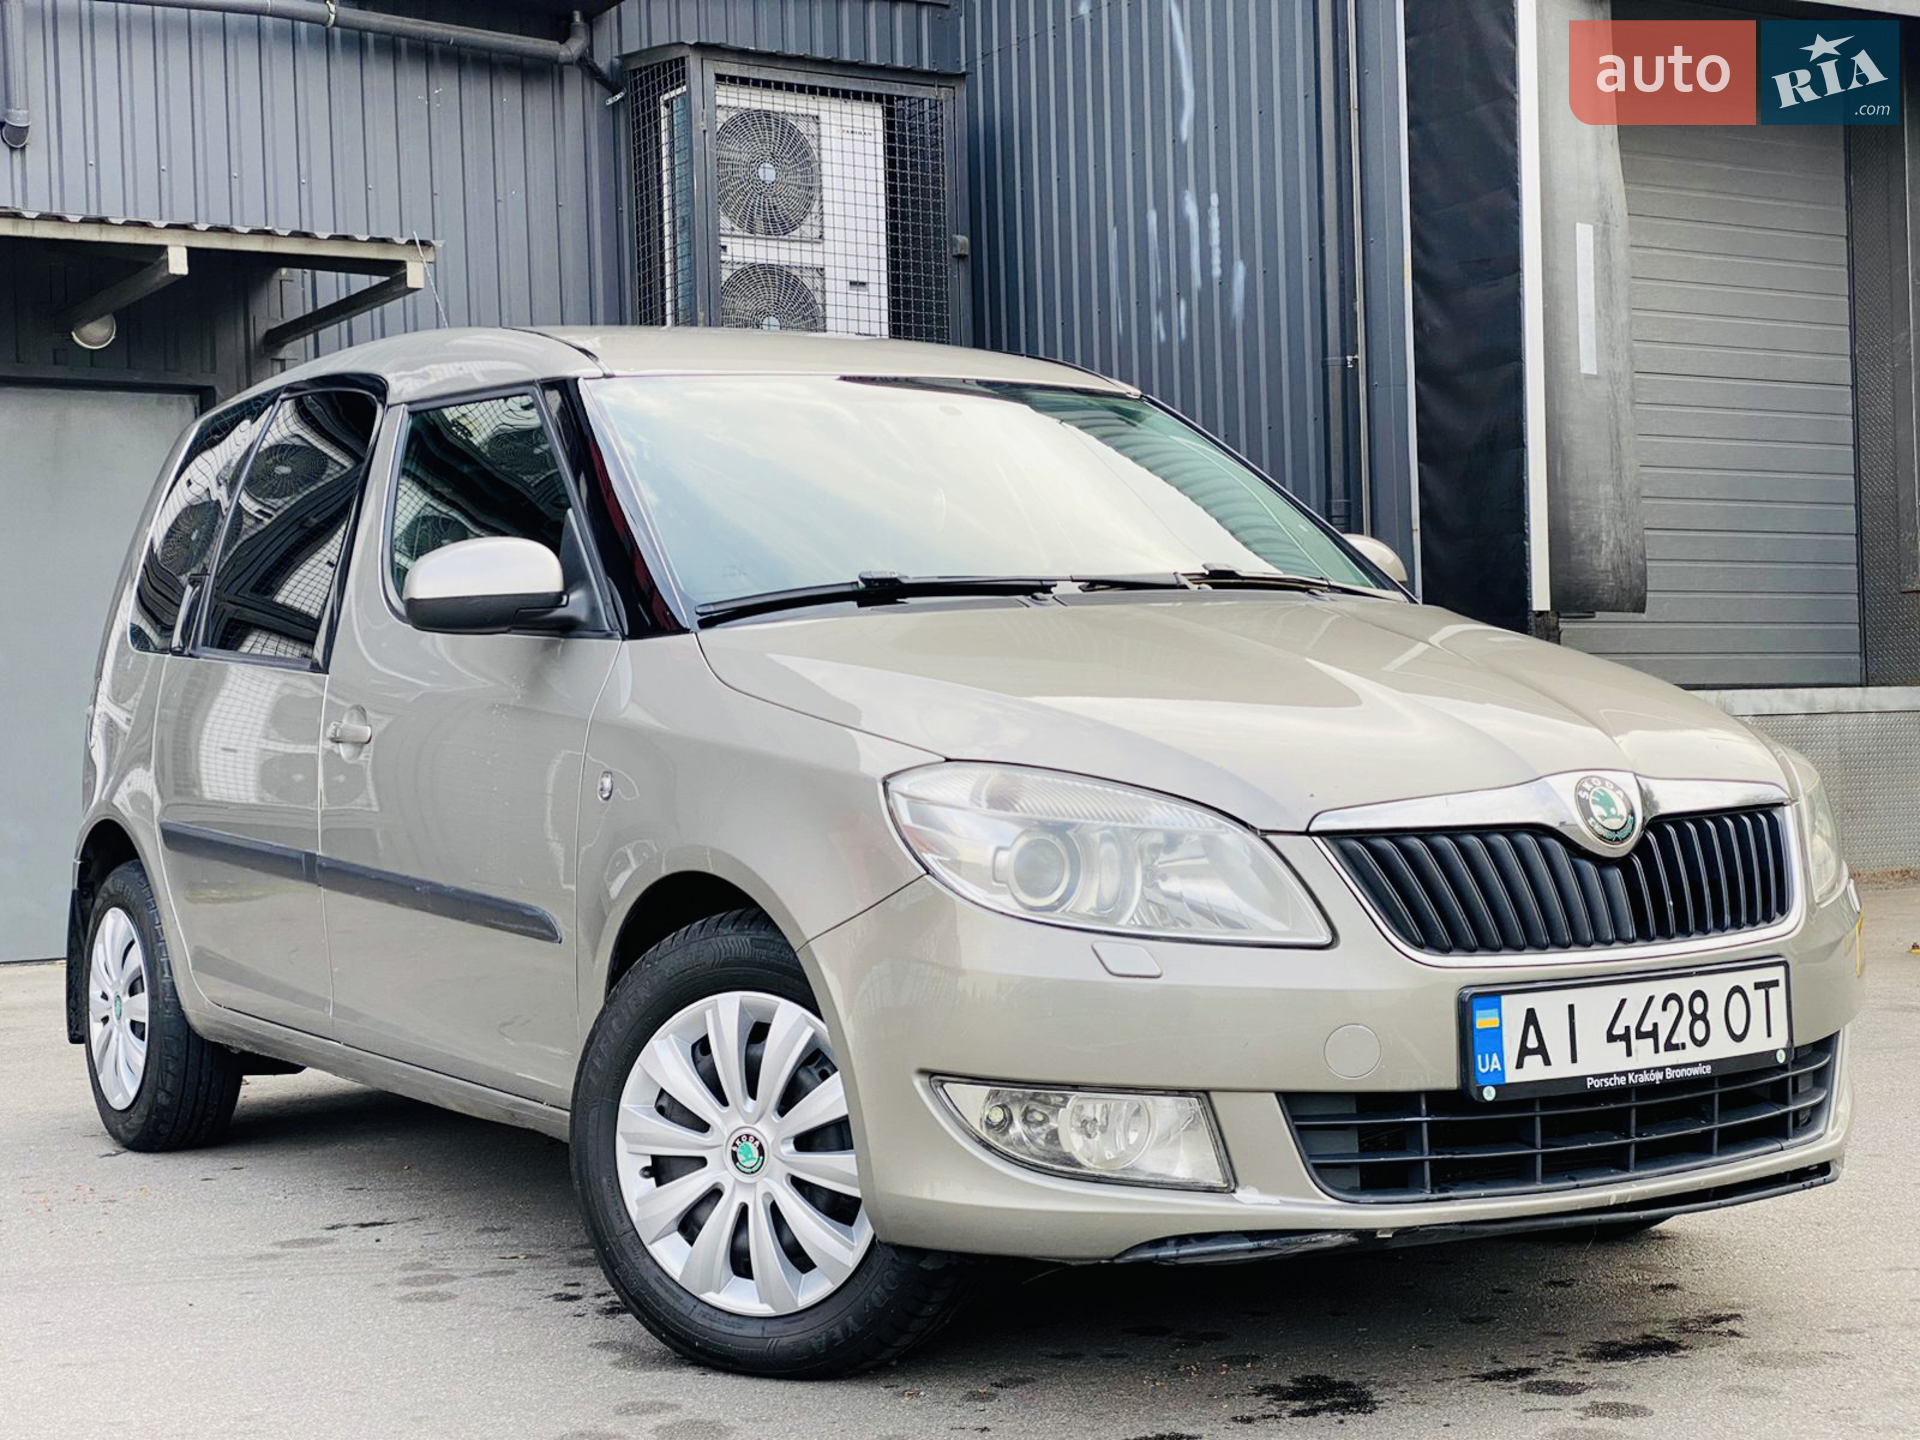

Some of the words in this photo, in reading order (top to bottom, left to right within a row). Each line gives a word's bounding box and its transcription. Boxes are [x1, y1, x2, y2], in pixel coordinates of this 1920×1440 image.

[1514, 1003, 1578, 1070] AI
[1606, 989, 1711, 1058] 4428
[1724, 979, 1780, 1044] OT
[1478, 1053, 1502, 1073] UA
[1586, 1073, 1626, 1089] Porsche
[1665, 1063, 1712, 1080] Bronowice
